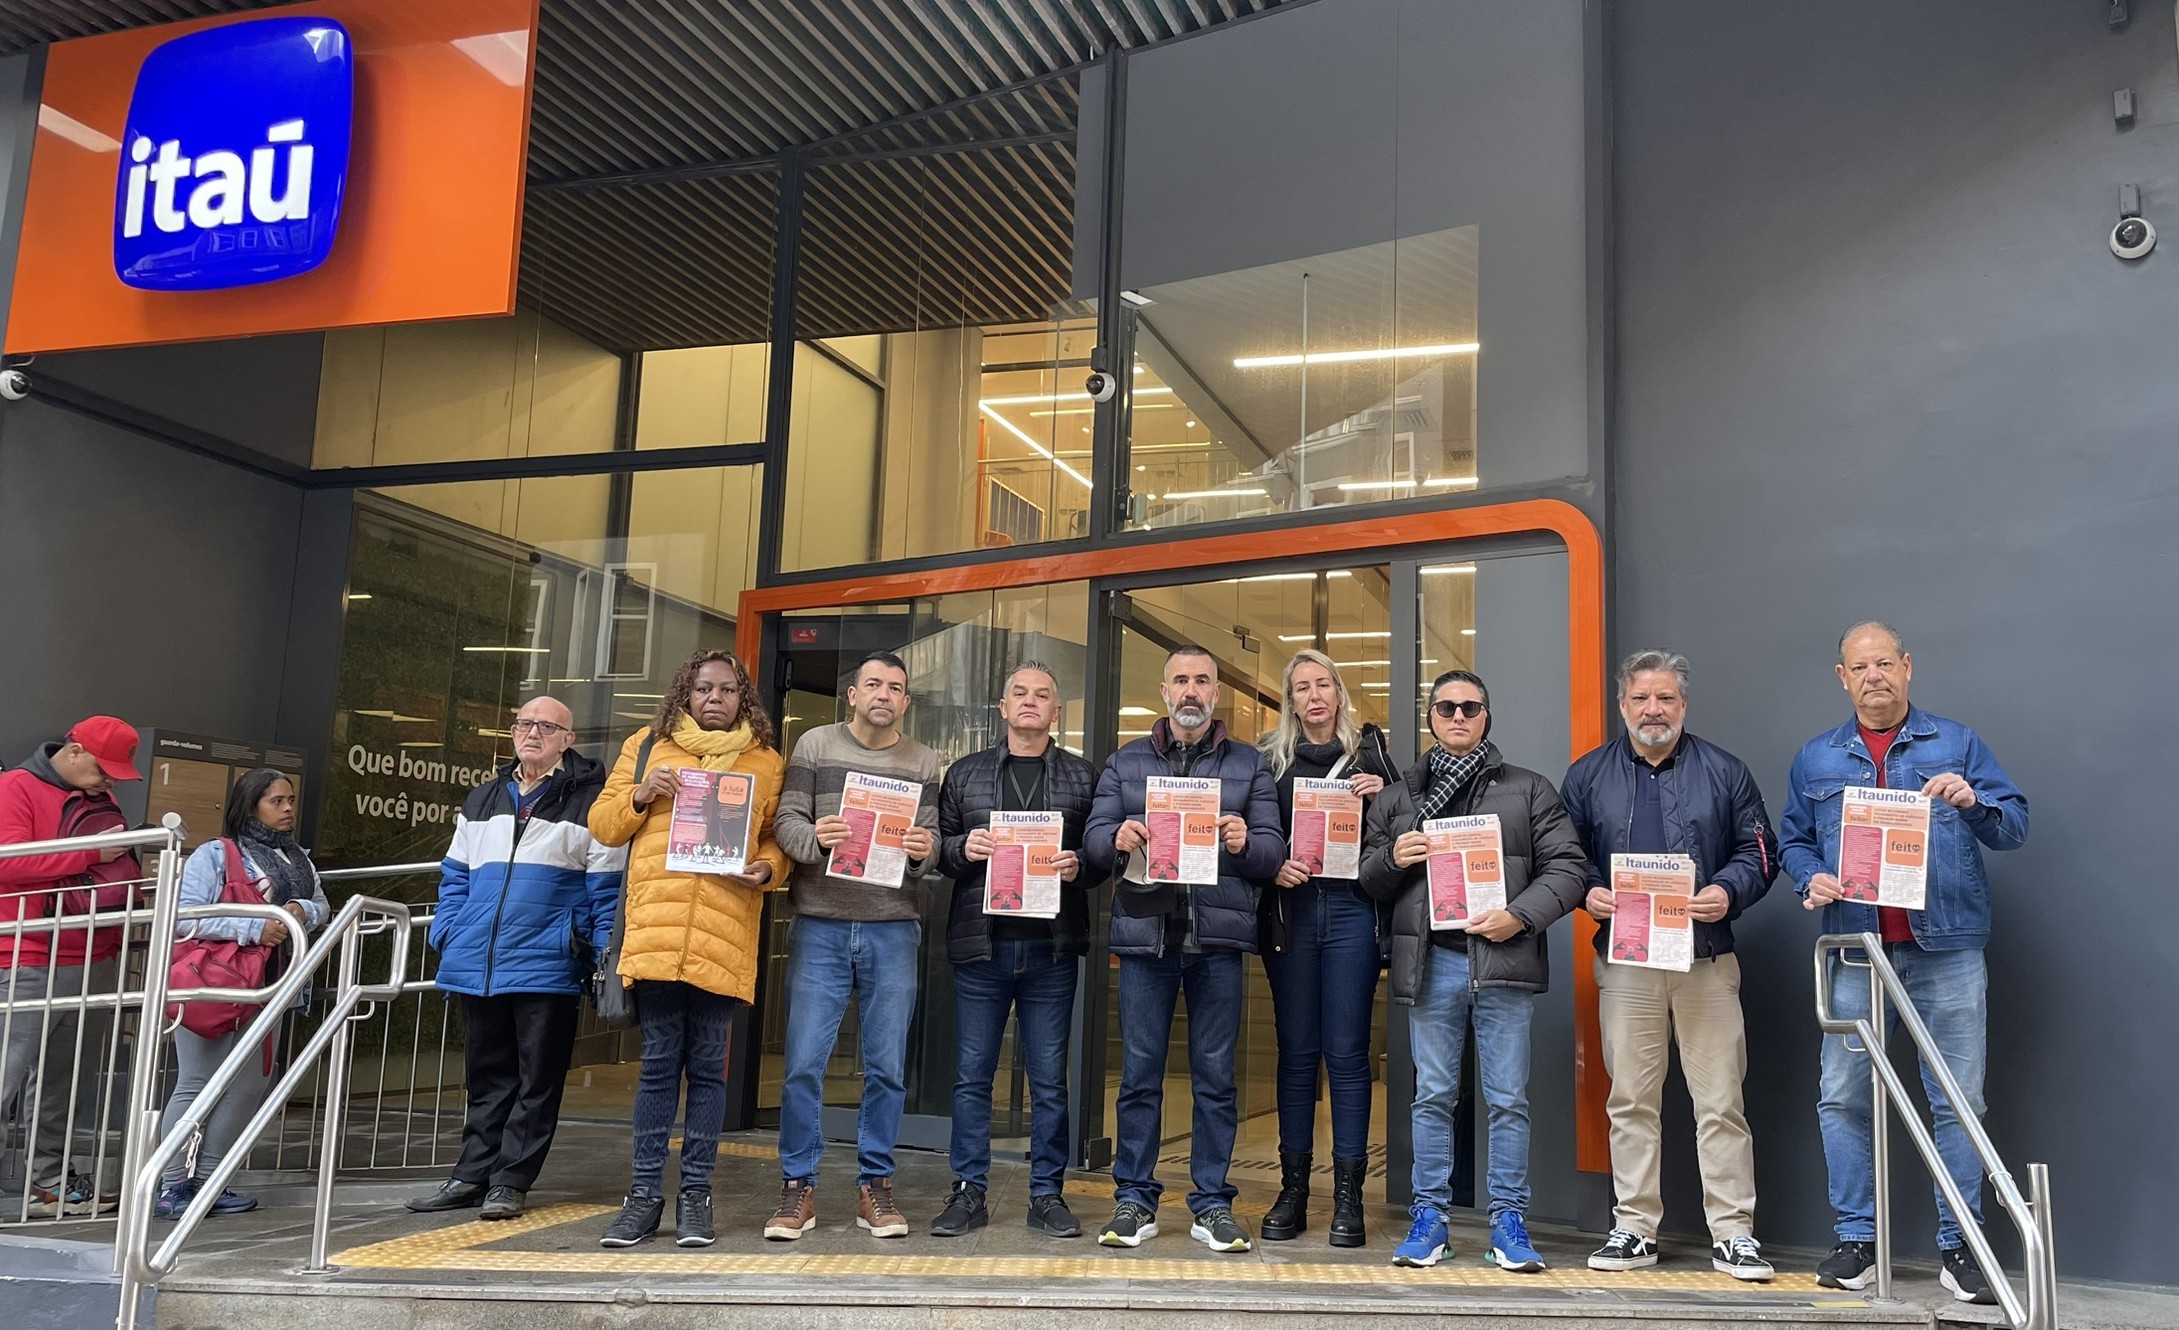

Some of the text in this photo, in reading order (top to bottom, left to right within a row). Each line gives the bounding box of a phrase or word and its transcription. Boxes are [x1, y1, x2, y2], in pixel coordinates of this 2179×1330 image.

[124, 119, 314, 238] itaú
[348, 744, 395, 776] Que
[398, 750, 447, 783] bom
[160, 763, 170, 785] 1
[859, 775, 910, 793] Itaunido
[1158, 778, 1209, 790] Itaunido
[1305, 779, 1352, 790] Itaunido
[1857, 788, 1917, 803] Itaunido
[355, 792, 409, 820] você
[411, 801, 449, 828] por
[1002, 813, 1051, 823] Itaunido
[1435, 817, 1486, 830] Itaunido
[1626, 857, 1680, 871] Itaunido
